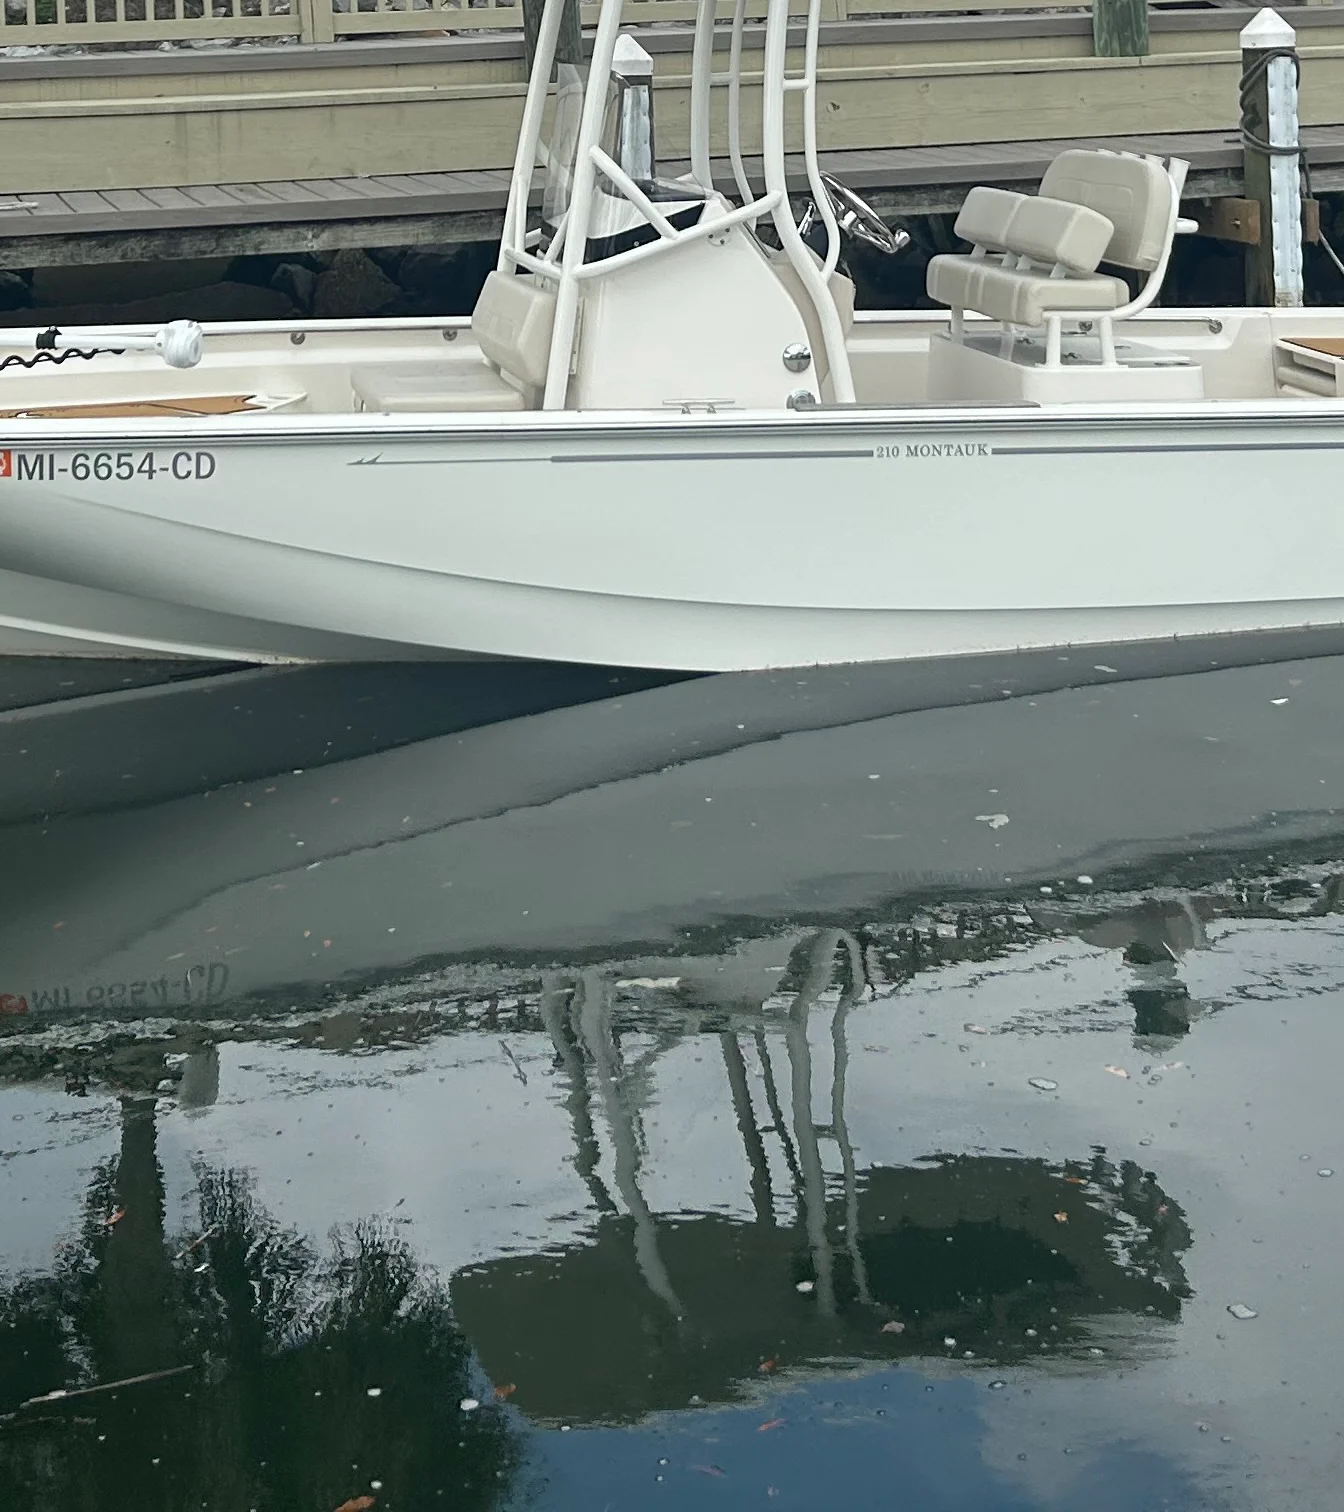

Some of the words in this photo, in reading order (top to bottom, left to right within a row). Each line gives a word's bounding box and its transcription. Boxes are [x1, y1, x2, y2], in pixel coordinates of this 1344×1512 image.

[876, 446, 900, 458] 210
[906, 443, 989, 457] MONTAUK
[17, 451, 217, 481] MI-6654-CD
